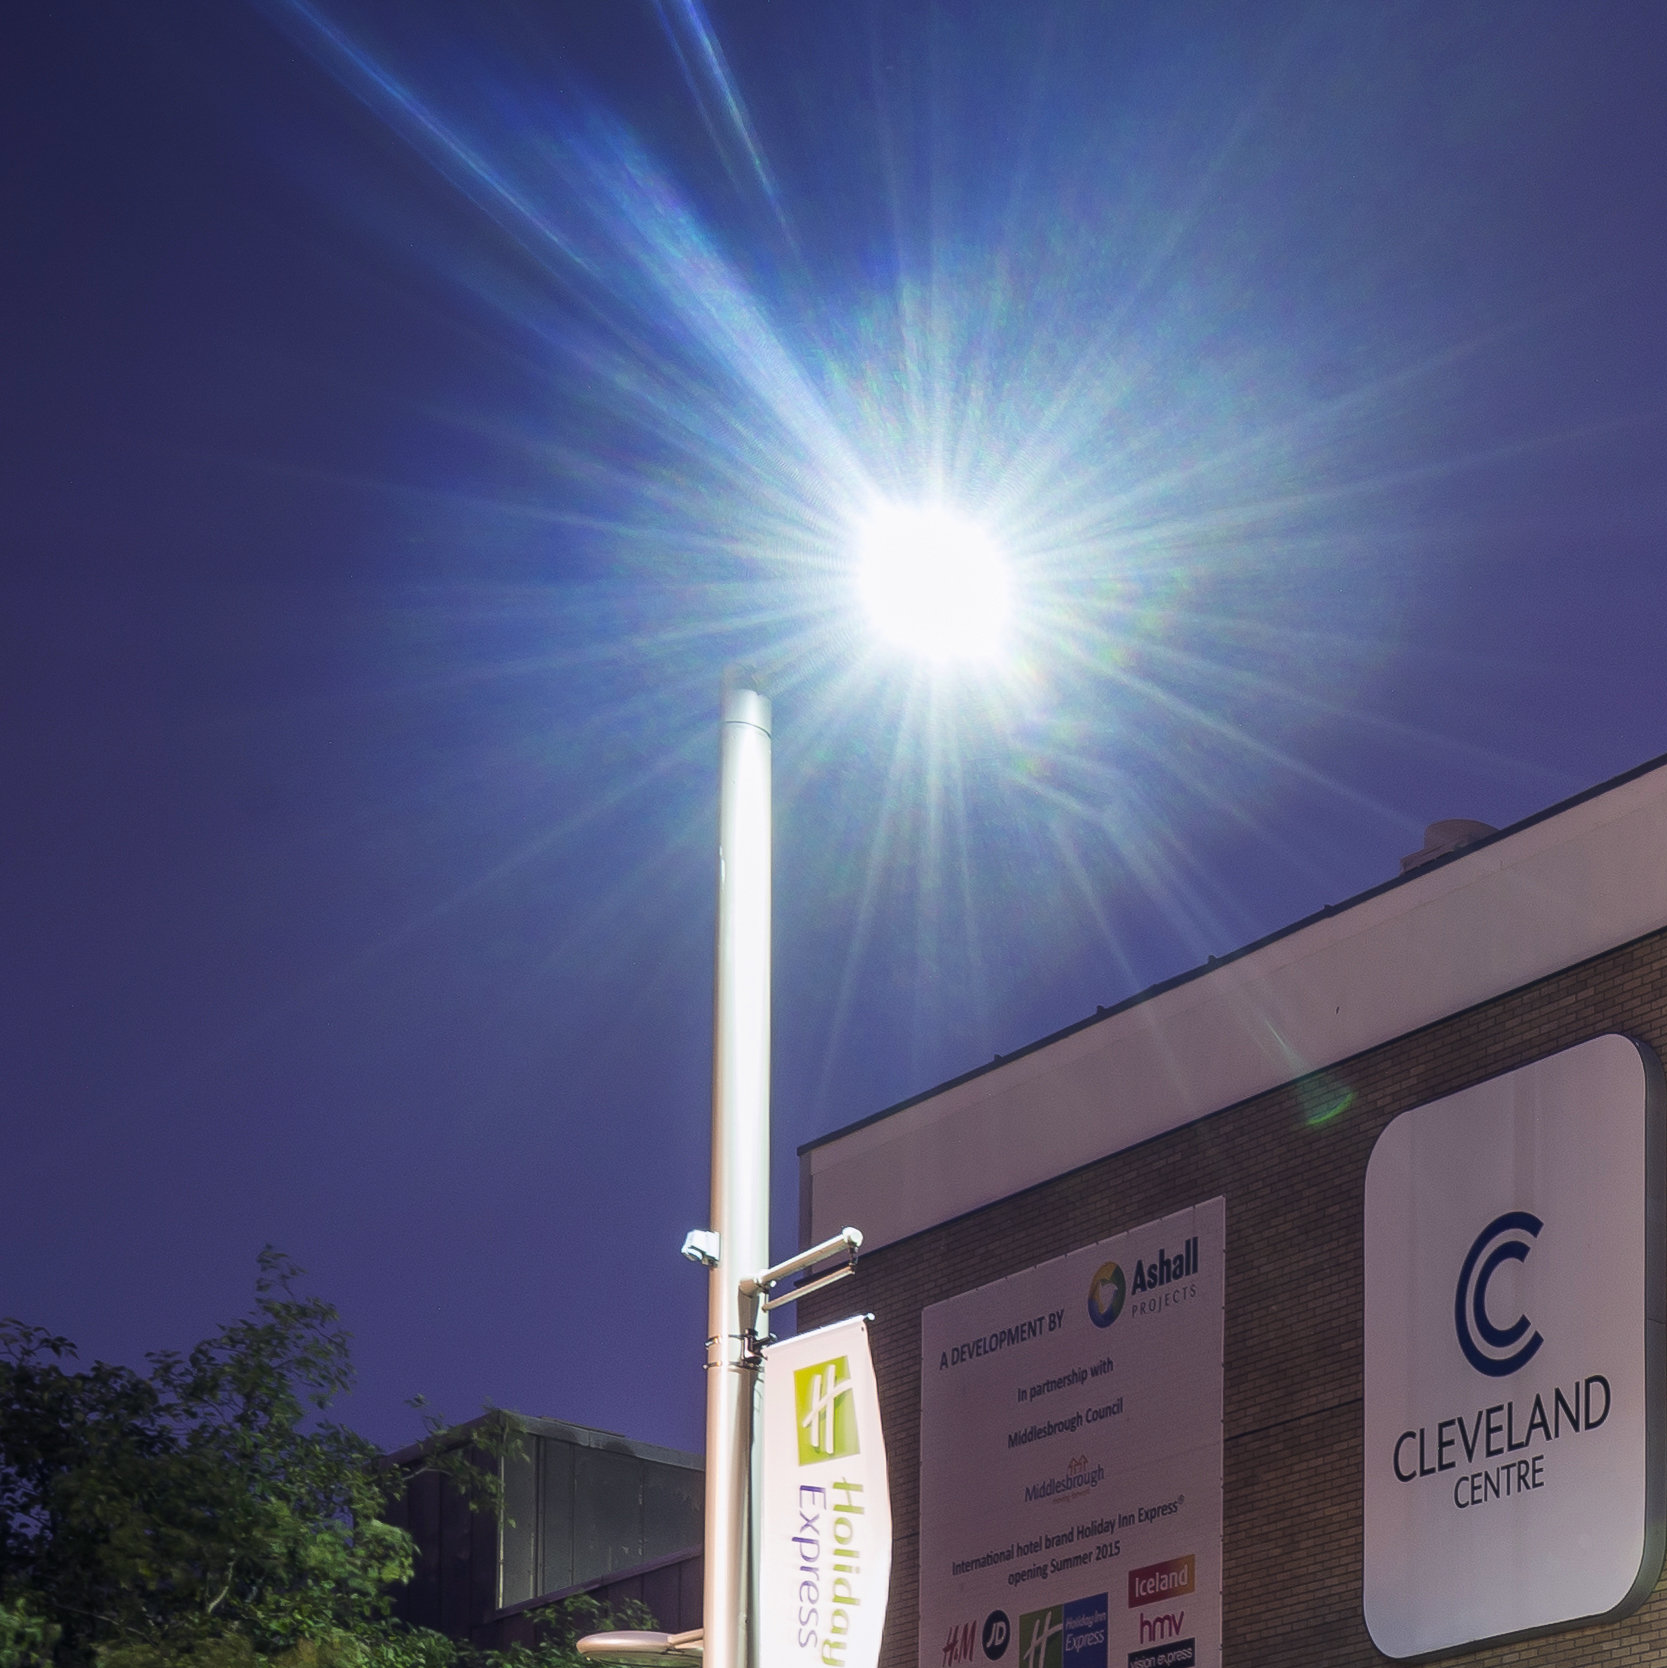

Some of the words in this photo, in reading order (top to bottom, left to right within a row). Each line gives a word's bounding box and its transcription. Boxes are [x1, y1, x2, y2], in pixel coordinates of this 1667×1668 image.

[1131, 1236, 1199, 1296] Ashall
[1131, 1283, 1197, 1318] PROJECTS
[939, 1348, 949, 1371] A
[951, 1316, 1045, 1367] DEVELOPMENT
[1048, 1308, 1065, 1333] BY
[1017, 1388, 1028, 1402] In
[1029, 1367, 1088, 1402] partnership
[1090, 1357, 1113, 1378] with
[1008, 1412, 1083, 1449] Middlesbrough
[1085, 1397, 1124, 1424] Council
[1393, 1373, 1612, 1484] CLEVELAND
[1025, 1463, 1105, 1502] Middlesbrough
[1453, 1453, 1545, 1511] CENTRE
[792, 1484, 826, 1649] Express
[952, 1544, 1014, 1576] International
[1016, 1535, 1043, 1559] hotel
[1045, 1528, 1074, 1551] brand
[1077, 1517, 1116, 1543] Holiday
[1118, 1512, 1135, 1529] Inn
[1008, 1563, 1049, 1587] opening
[1050, 1551, 1093, 1574] Summer
[1095, 1540, 1121, 1561] 2015
[822, 1476, 865, 1668] Holiday
[1135, 1564, 1188, 1598] Iceland
[942, 1619, 977, 1668] H&M
[986, 1621, 1006, 1649] JD
[1065, 1629, 1105, 1653] Express
[1140, 1610, 1185, 1645] hmv
[1157, 1647, 1193, 1667] express
